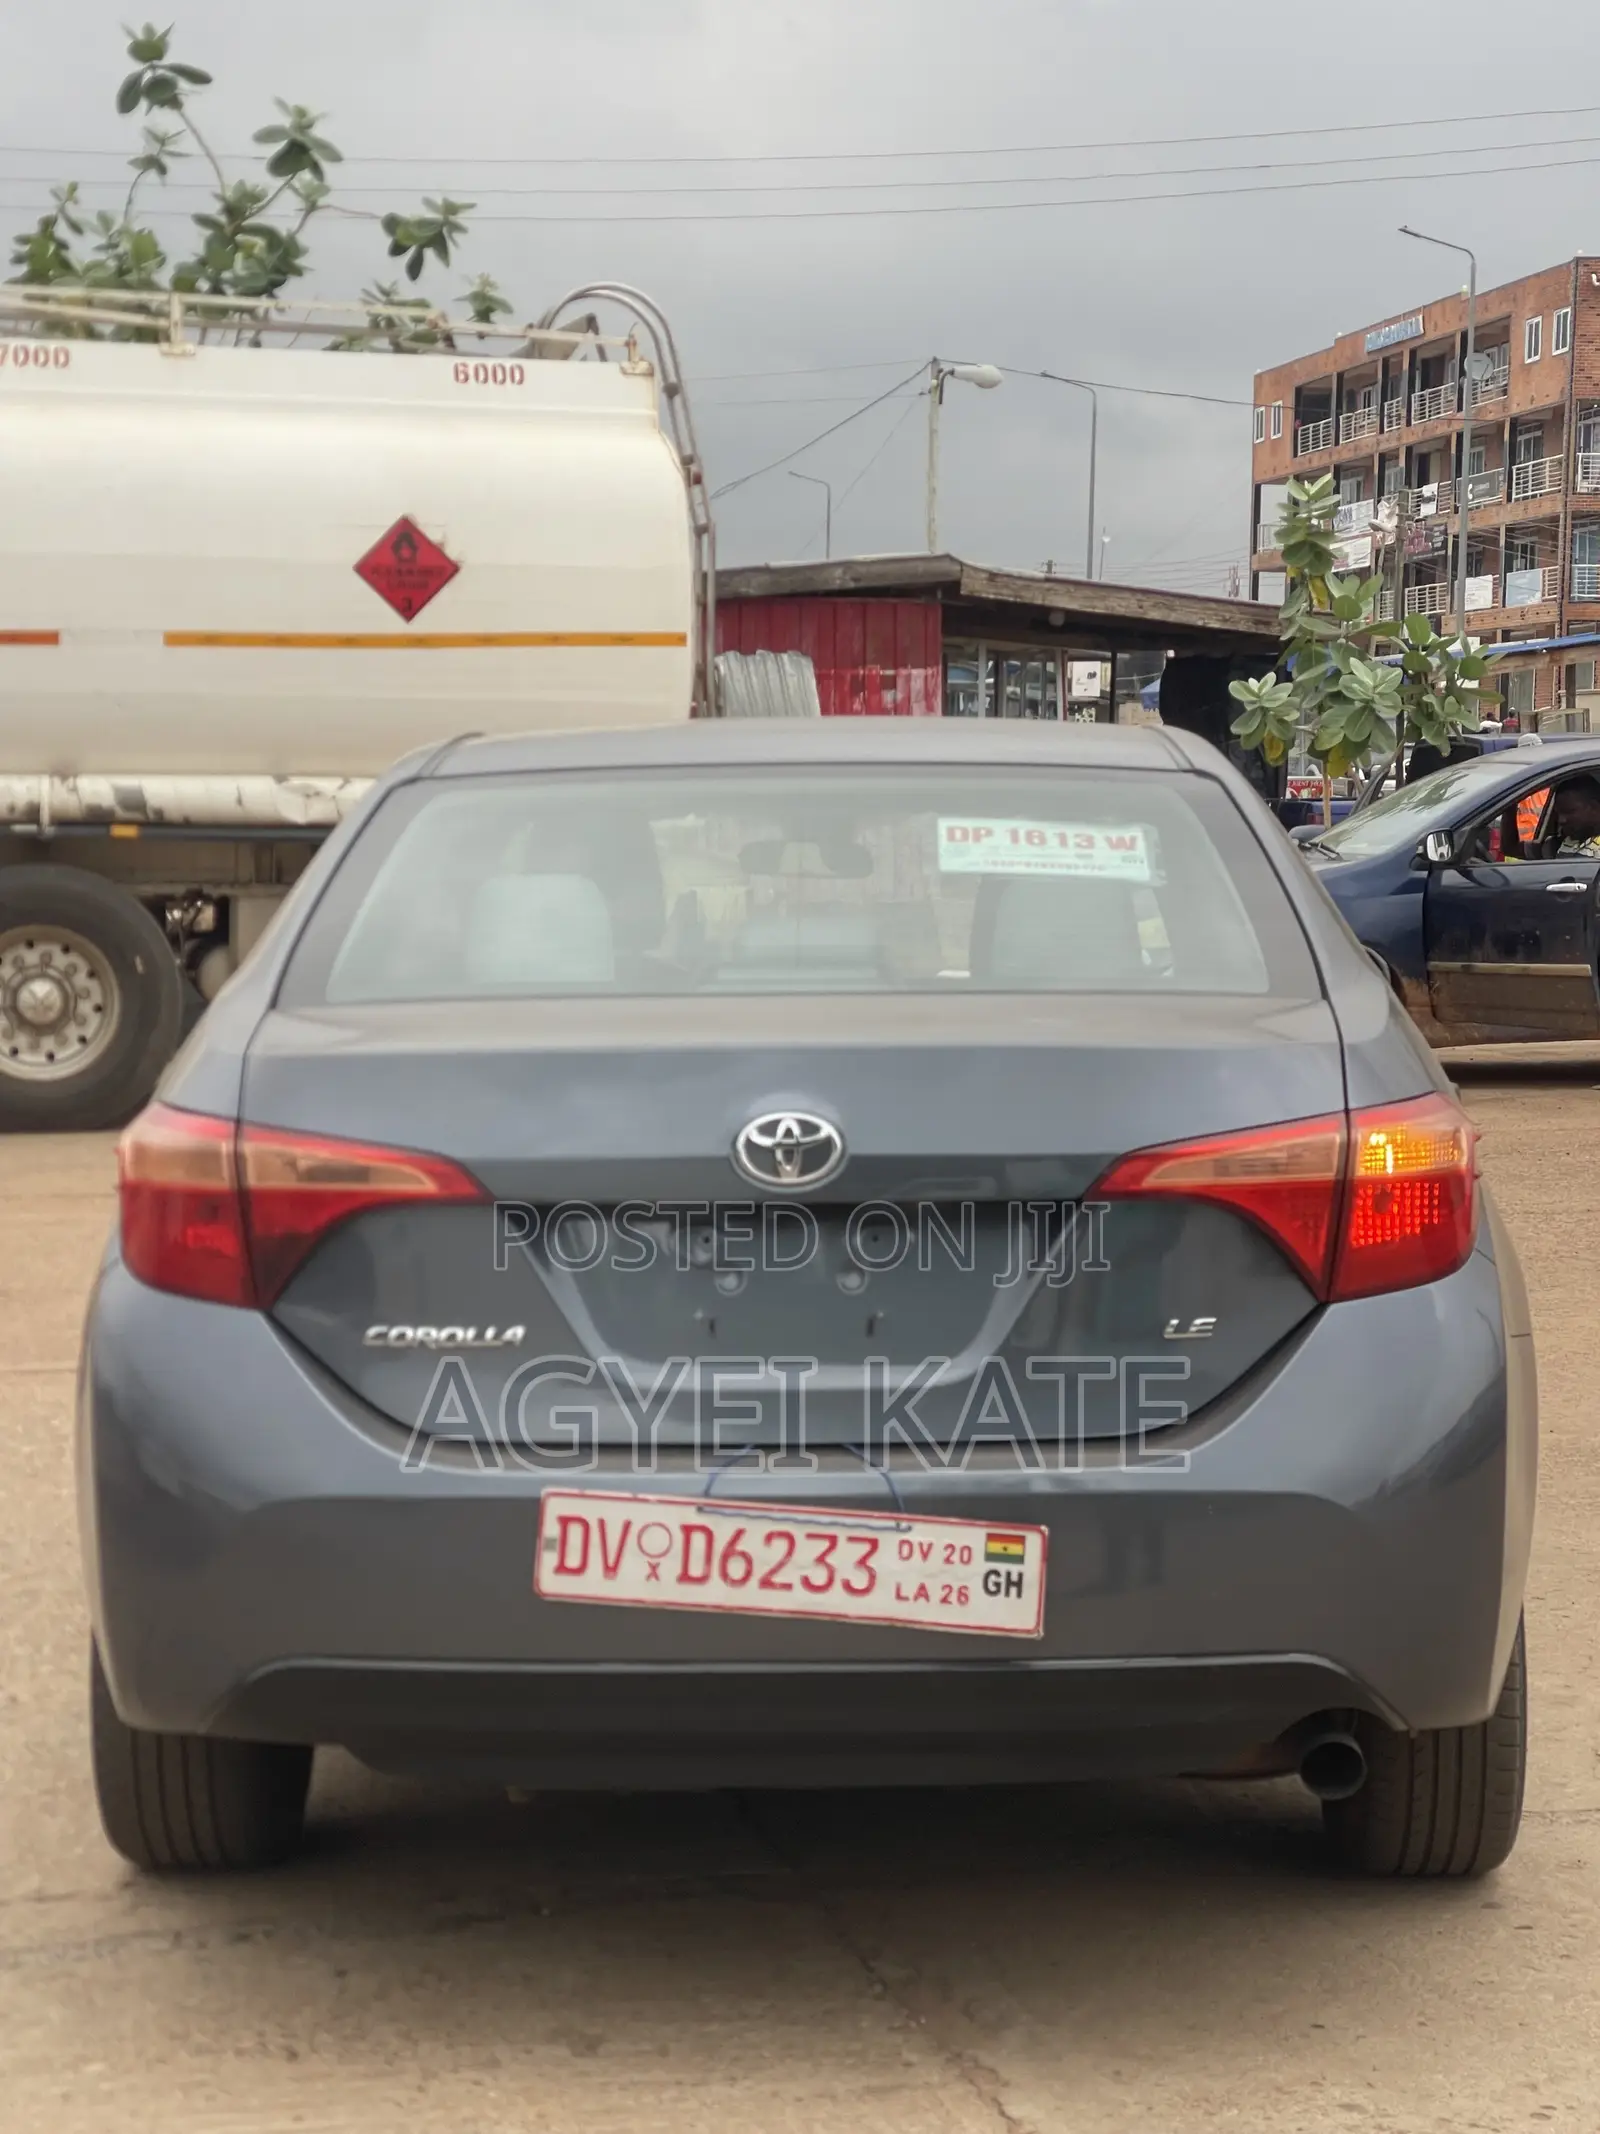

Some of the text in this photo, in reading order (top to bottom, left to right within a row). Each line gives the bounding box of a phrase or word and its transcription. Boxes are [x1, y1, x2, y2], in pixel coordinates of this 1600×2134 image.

[453, 362, 525, 385] 6000
[946, 826, 993, 843] DP
[1104, 834, 1138, 851] W
[363, 1324, 527, 1349] COROLLA
[1163, 1317, 1217, 1340] LE
[898, 1539, 972, 1565] DV 20
[894, 1581, 970, 1606] LA 26
[982, 1568, 1024, 1599] GH
